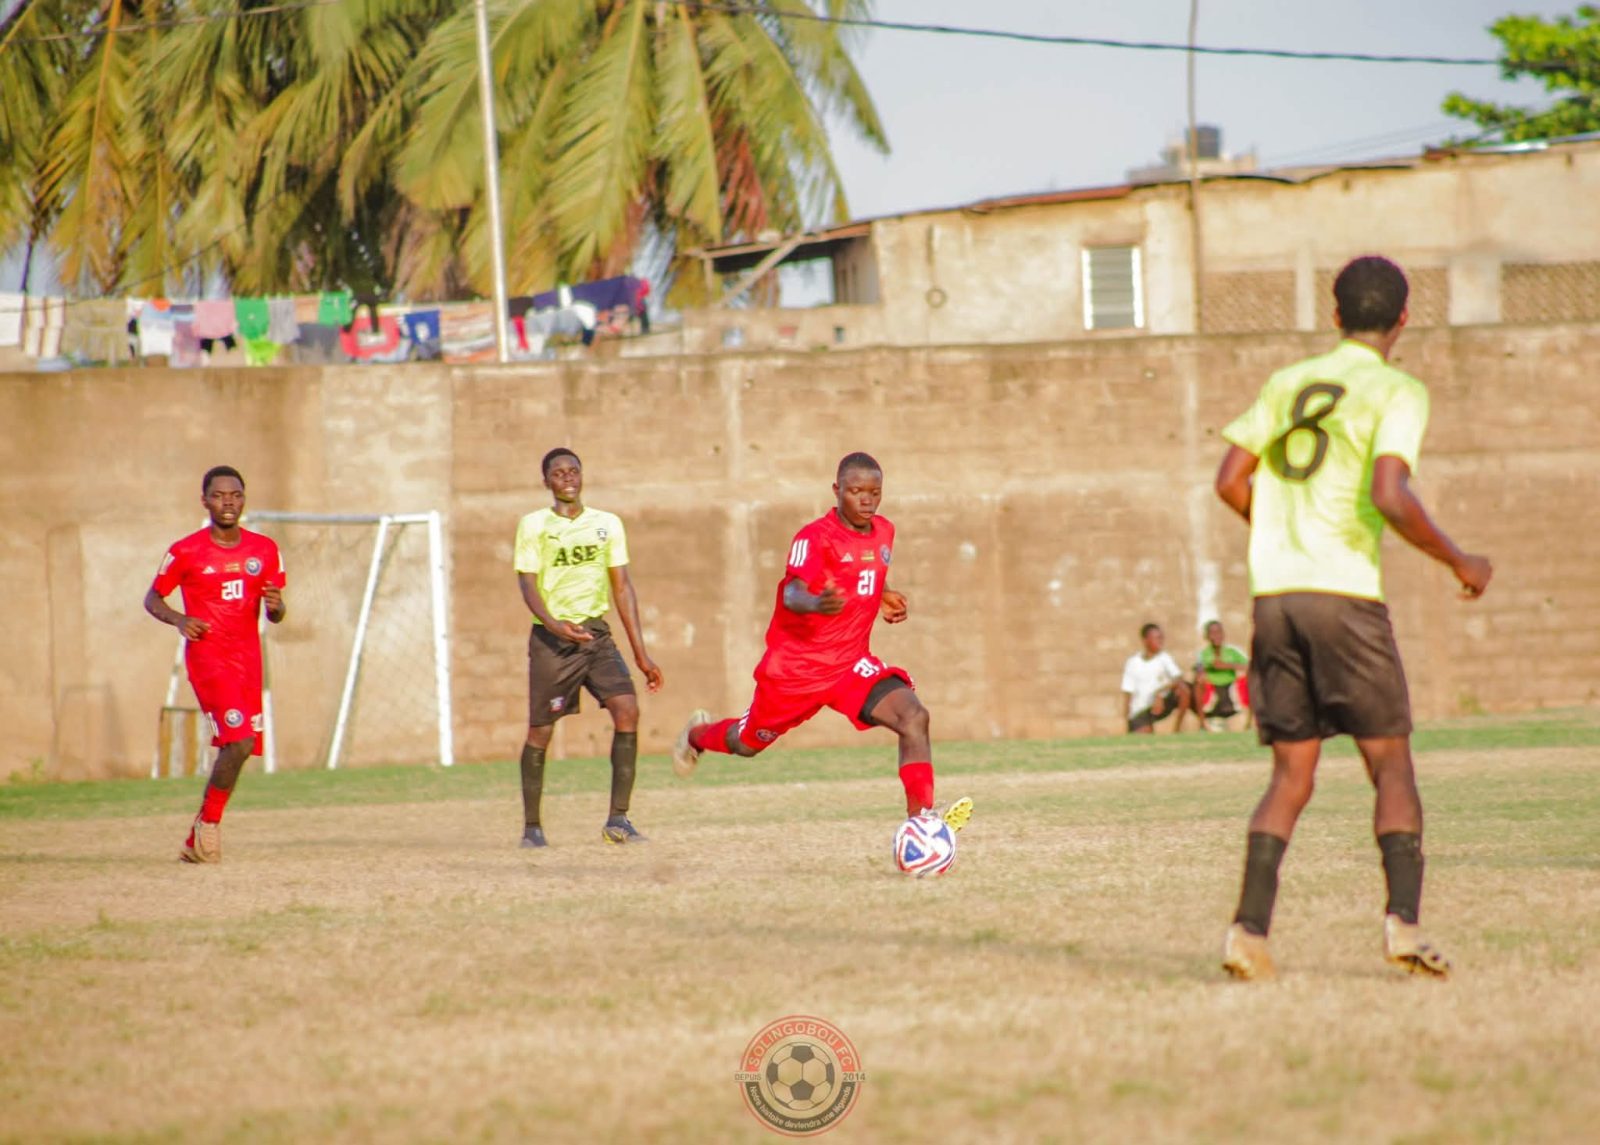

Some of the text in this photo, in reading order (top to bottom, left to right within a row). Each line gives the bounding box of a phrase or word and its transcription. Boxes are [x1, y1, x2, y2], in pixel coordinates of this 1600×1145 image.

[1268, 382, 1346, 481] 8
[221, 579, 244, 601] 20
[857, 569, 876, 596] 21
